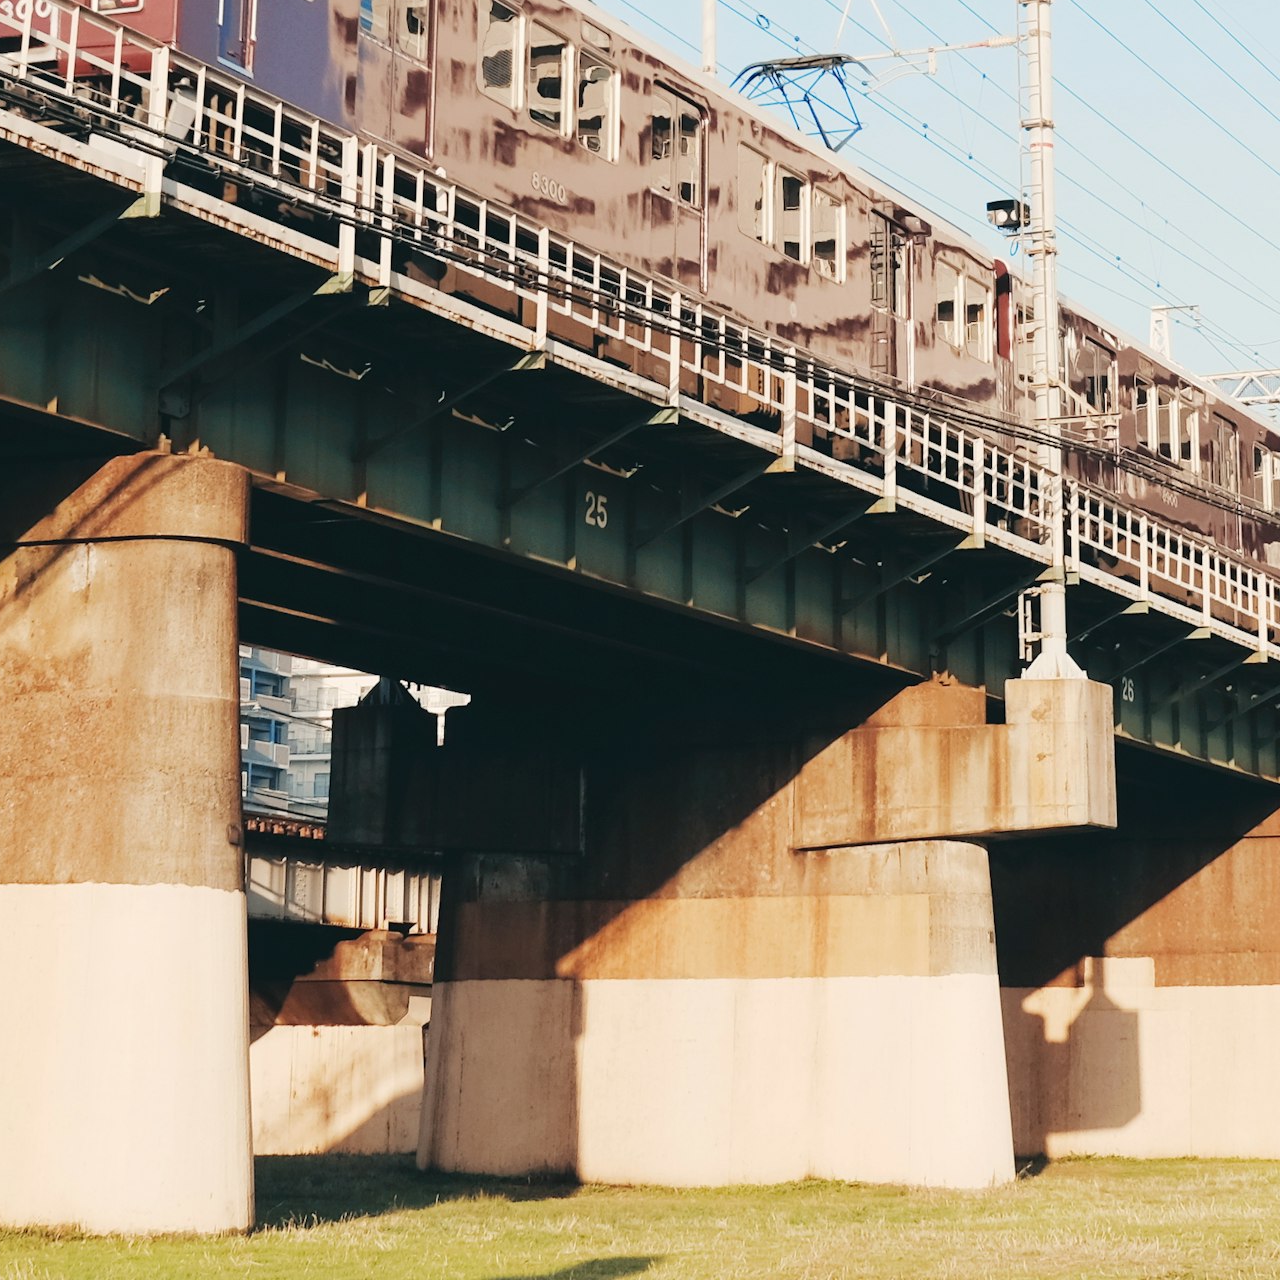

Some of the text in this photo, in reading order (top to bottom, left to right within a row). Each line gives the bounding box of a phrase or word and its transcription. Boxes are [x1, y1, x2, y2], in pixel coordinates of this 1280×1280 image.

[531, 171, 566, 204] 8300
[585, 491, 608, 529] 25
[1122, 676, 1135, 702] 26
